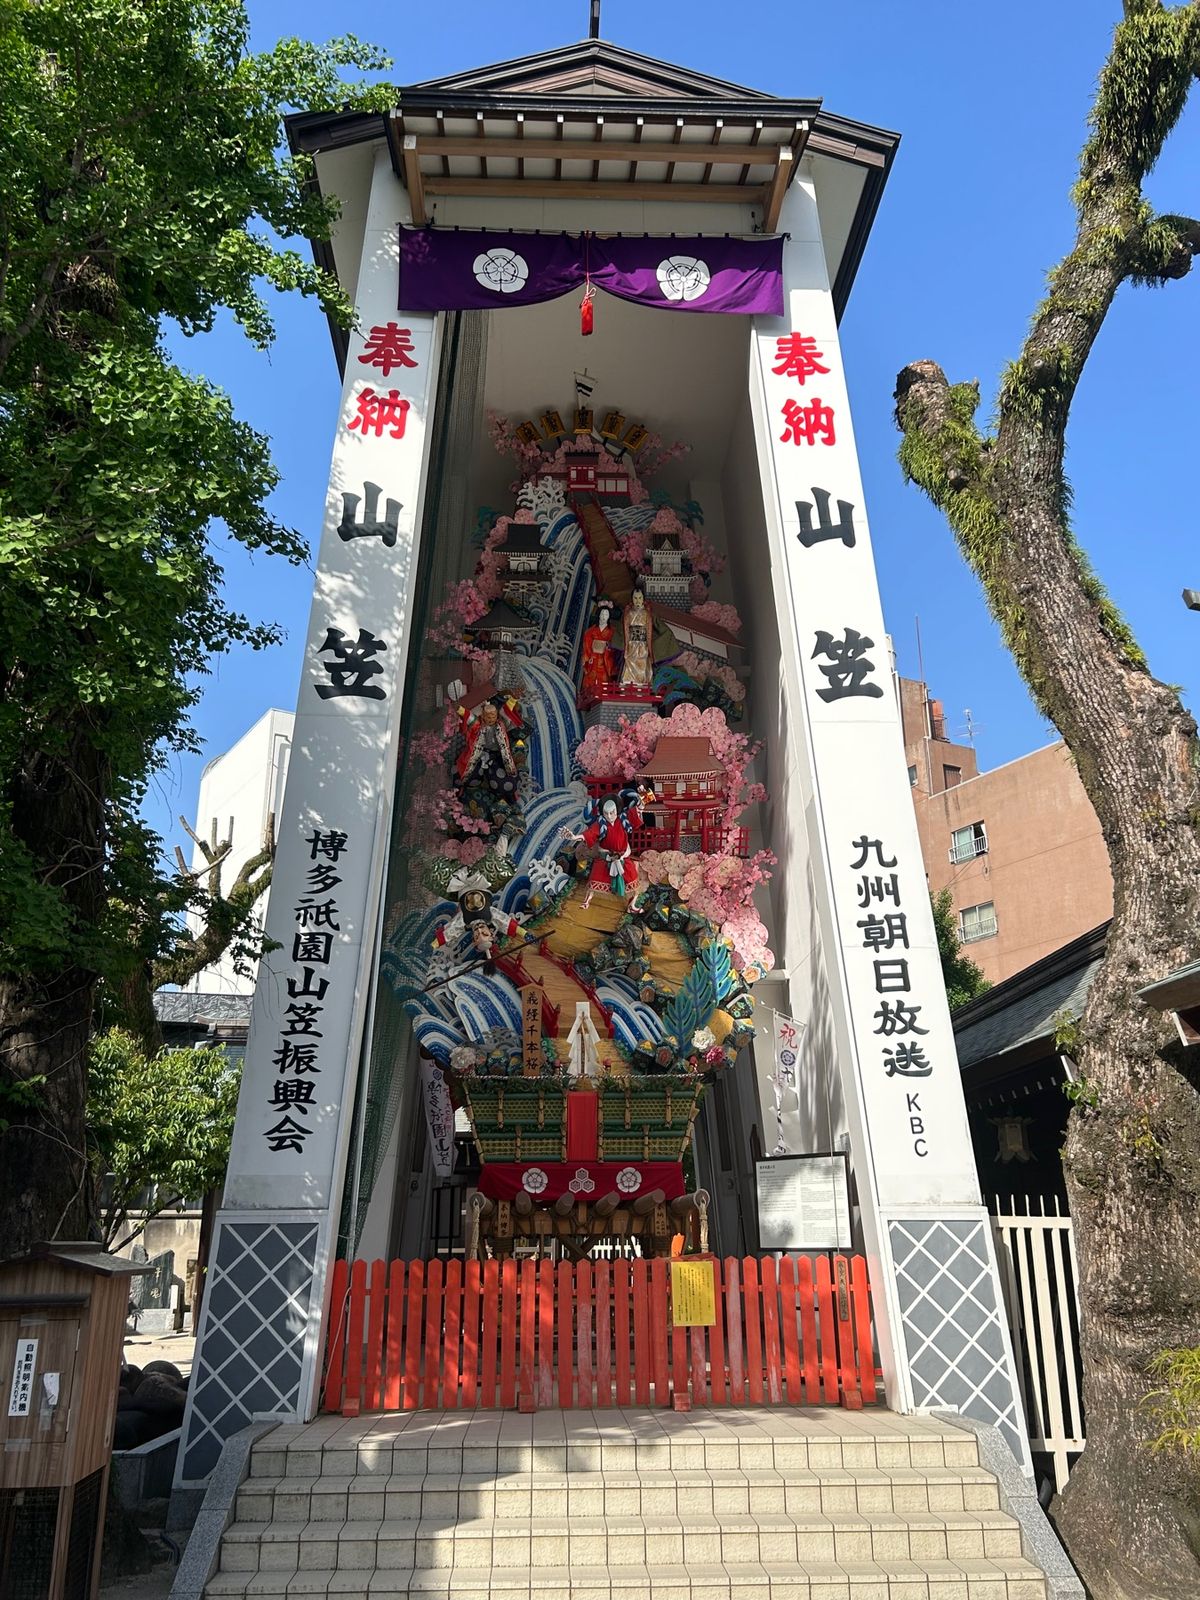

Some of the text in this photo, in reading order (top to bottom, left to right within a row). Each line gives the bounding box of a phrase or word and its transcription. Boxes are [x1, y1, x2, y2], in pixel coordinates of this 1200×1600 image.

[314, 323, 420, 702] 奉納 山笠
[771, 331, 885, 703] 奉納 山笠
[262, 829, 349, 1154] 博多祇園山笠振興会
[526, 991, 540, 1070] 義経千本桜
[778, 1023, 798, 1049] 祝
[849, 834, 934, 1078] 九州朝日放送
[905, 1092, 929, 1158] KBC
[18, 1344, 34, 1411] 自動照明案内機
